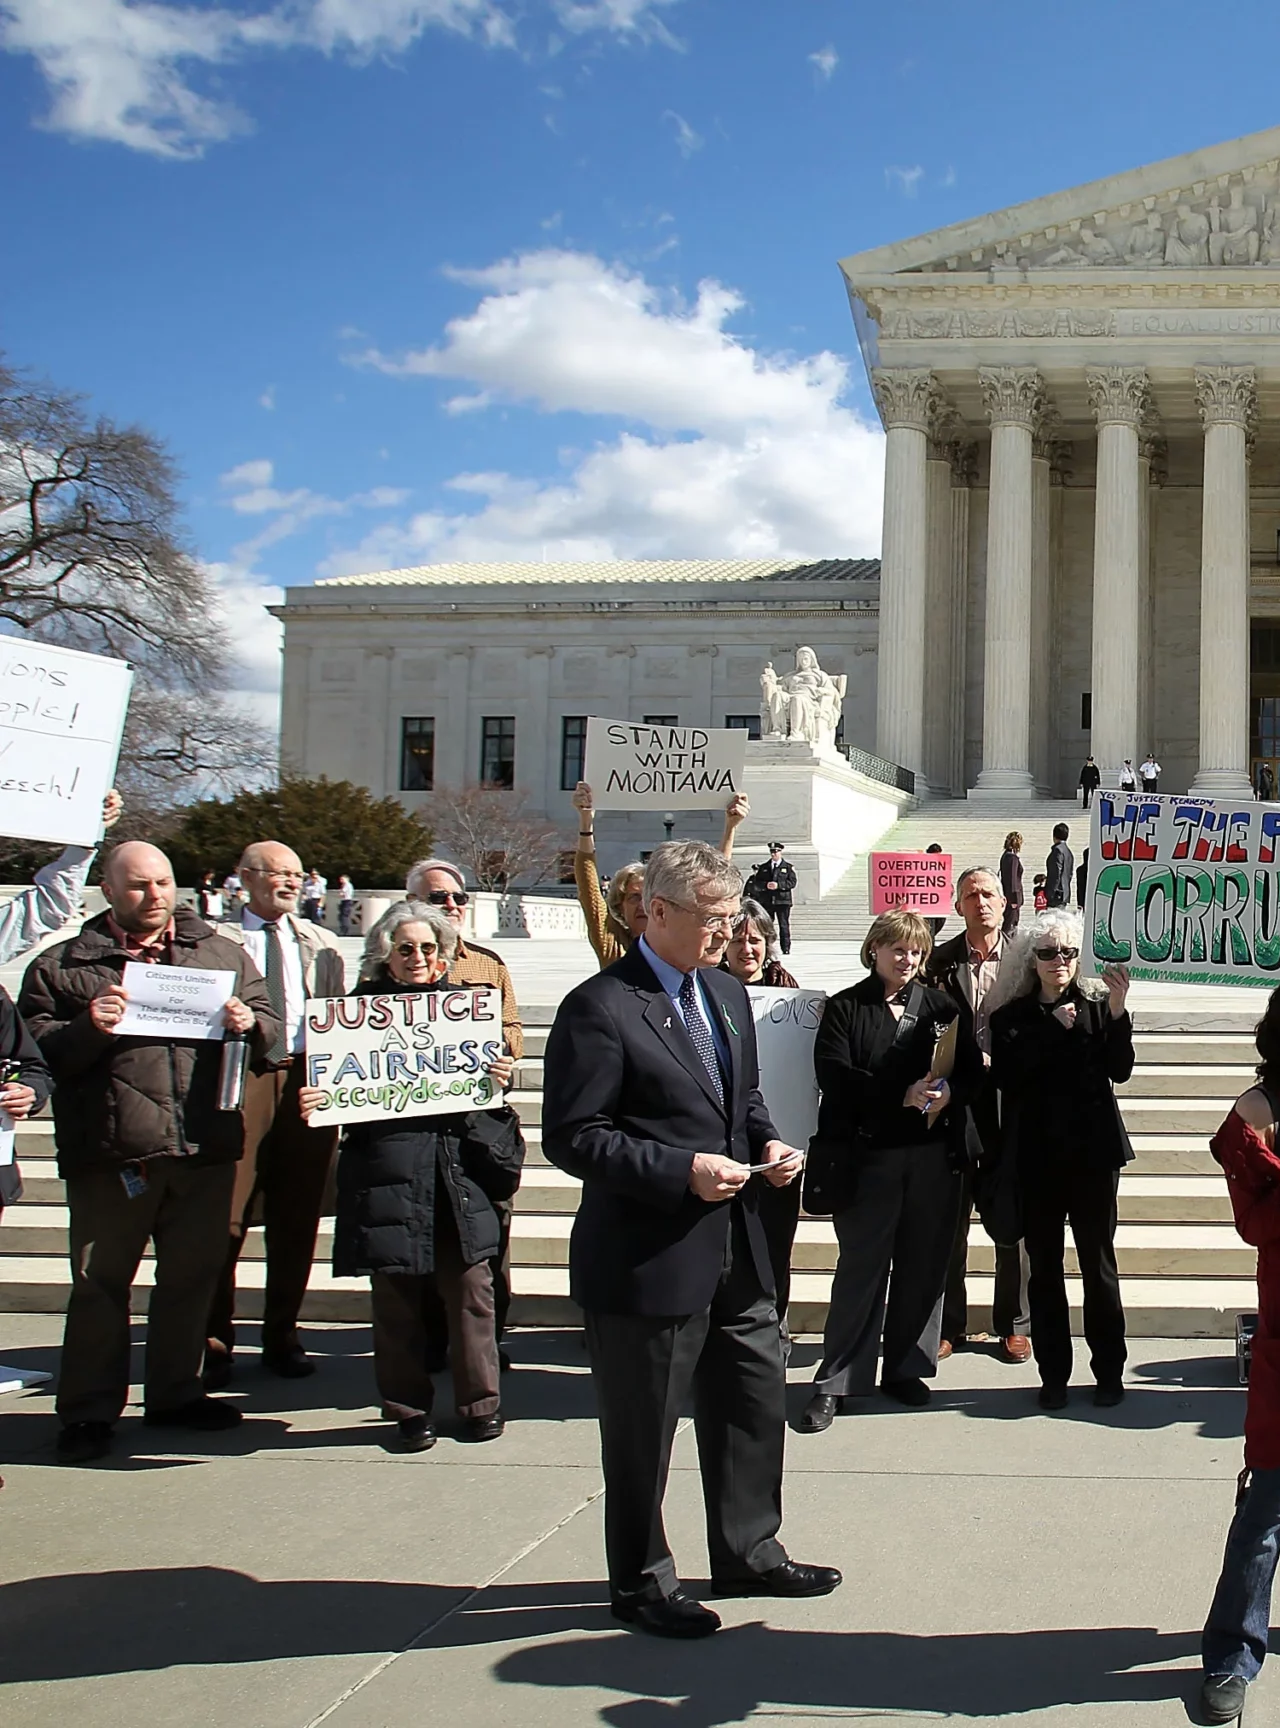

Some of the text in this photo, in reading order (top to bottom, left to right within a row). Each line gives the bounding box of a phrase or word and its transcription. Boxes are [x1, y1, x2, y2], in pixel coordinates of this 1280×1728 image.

[1132, 315, 1203, 332] EQUAL
[607, 725, 708, 750] STAND
[635, 751, 705, 768] WITH
[0, 767, 80, 800] eech!
[606, 769, 735, 793] MONTANA
[1100, 800, 1161, 862] WE
[1172, 806, 1250, 863] THE
[878, 861, 946, 871] OVERTURN
[878, 875, 946, 888] CITIZENS
[885, 892, 940, 904] UNITED
[145, 971, 216, 985] Citizens United
[169, 996, 184, 1004] For
[141, 1005, 158, 1013] The
[161, 1007, 181, 1015] Best
[309, 990, 494, 1034] JUSTICE
[136, 1014, 170, 1024] Money
[172, 1016, 190, 1024] Can
[380, 1022, 435, 1052] AS
[308, 1040, 500, 1086] FAIRNESS
[316, 1077, 494, 1112] occupydc.org
